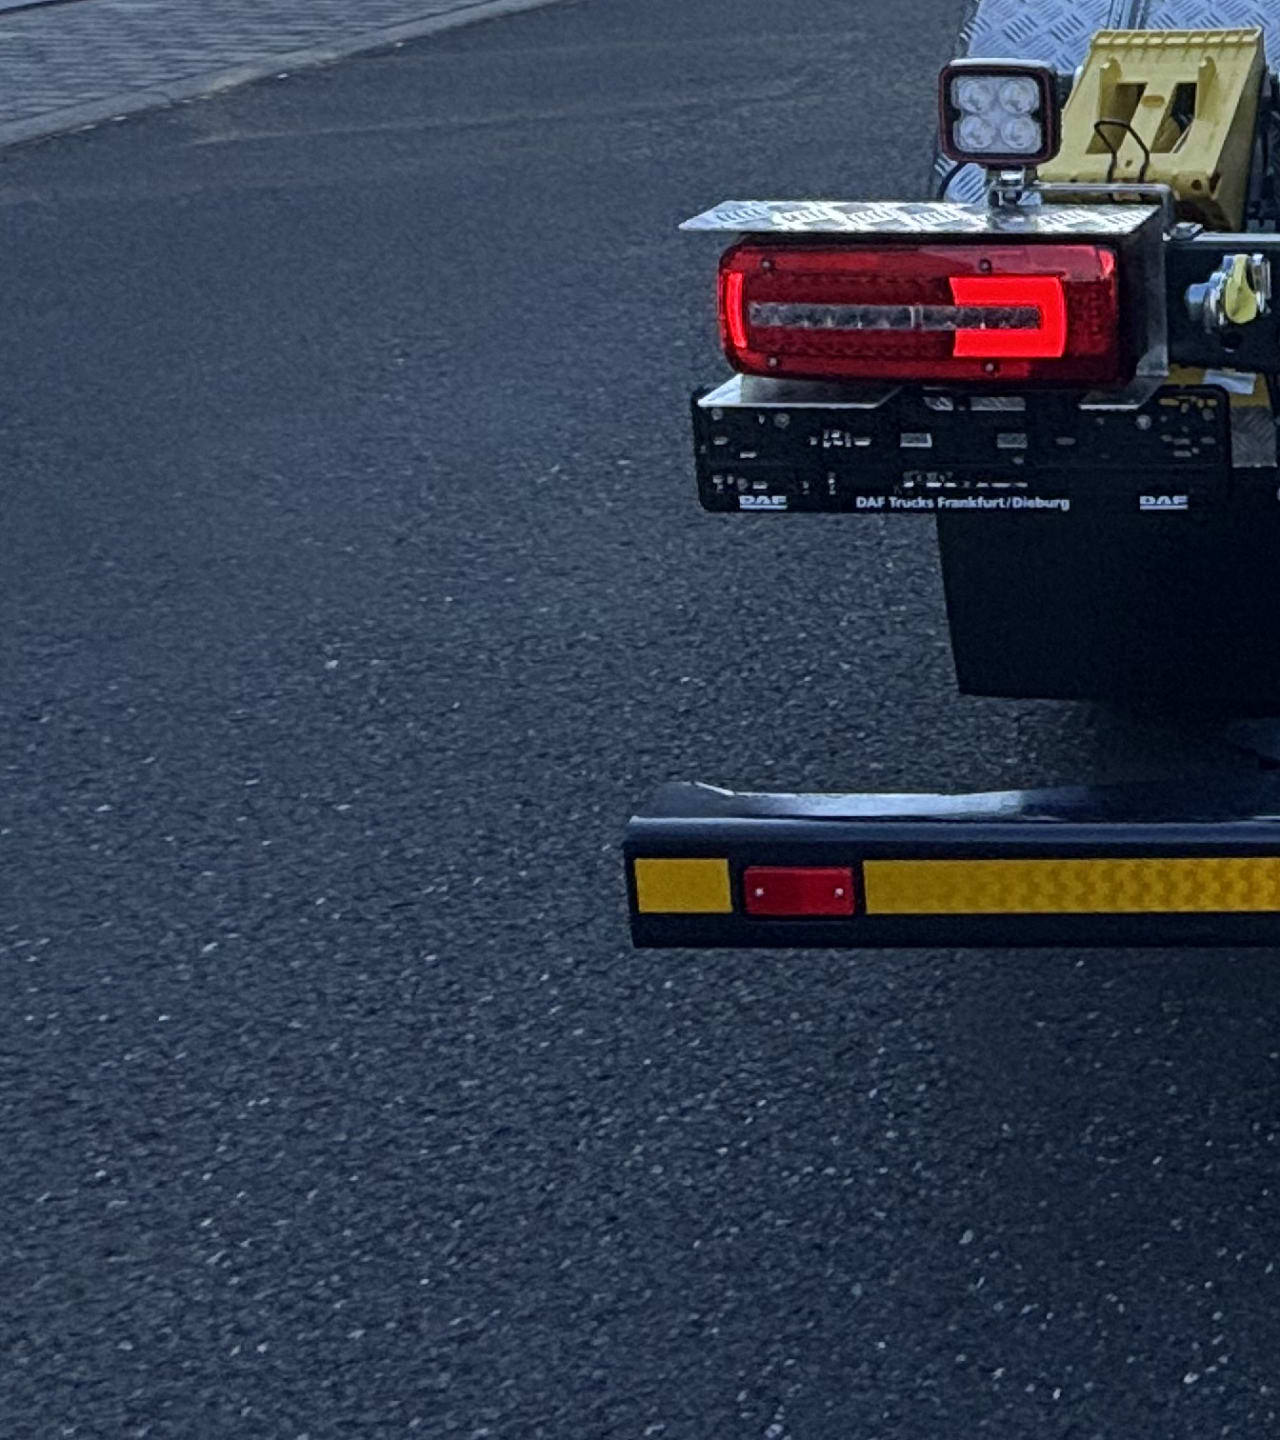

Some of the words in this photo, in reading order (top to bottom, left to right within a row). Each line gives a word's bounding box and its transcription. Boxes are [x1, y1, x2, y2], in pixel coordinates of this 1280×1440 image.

[738, 495, 788, 508] DAF
[855, 496, 885, 508] DAF
[889, 496, 935, 509] Trucks
[1139, 495, 1189, 508] DAF
